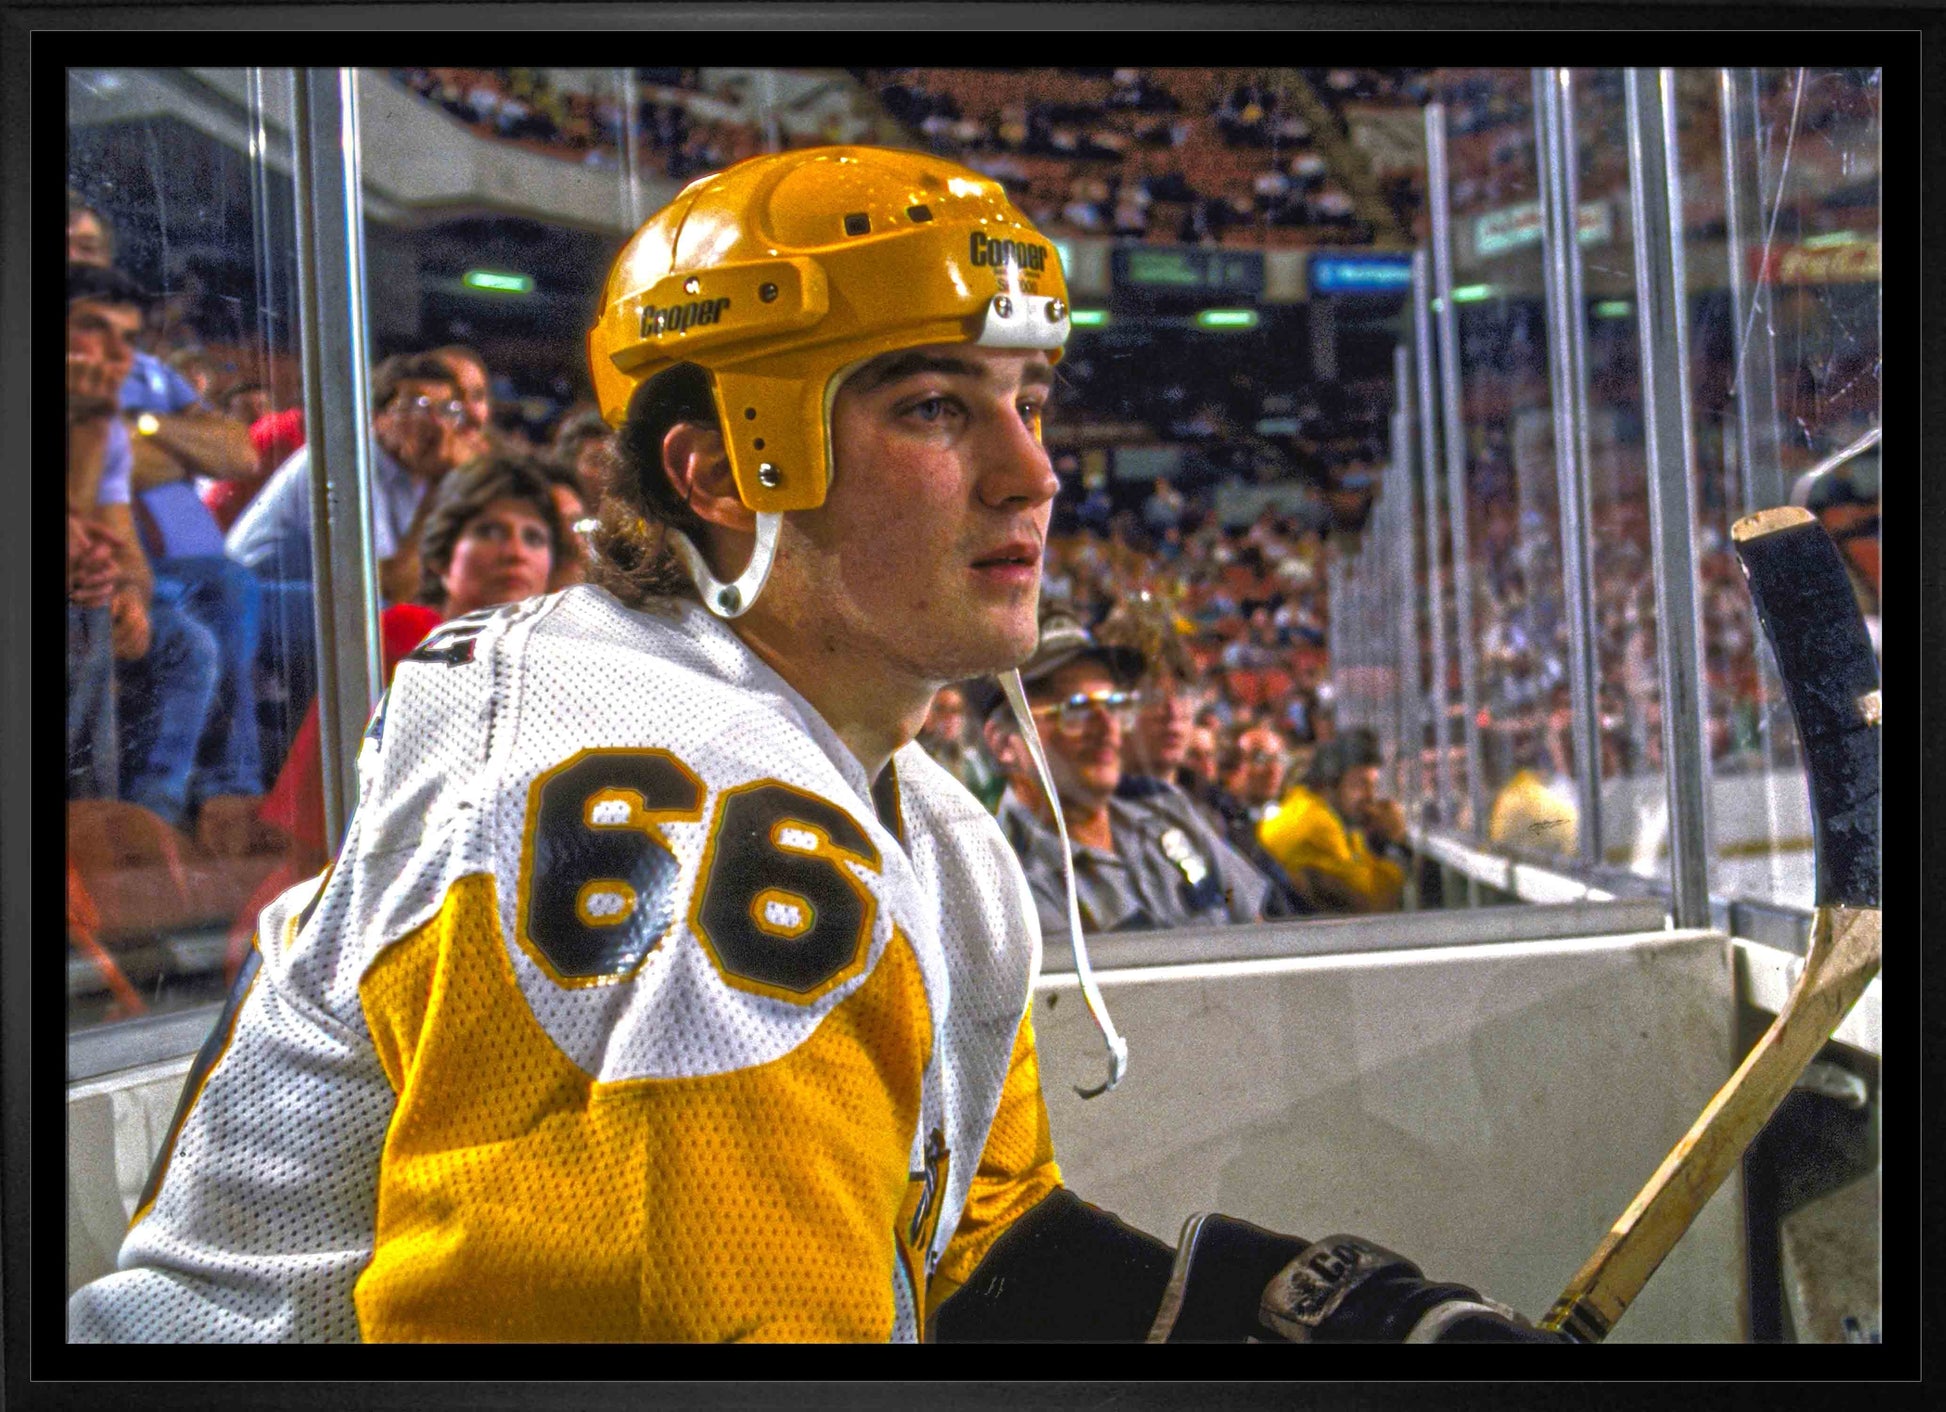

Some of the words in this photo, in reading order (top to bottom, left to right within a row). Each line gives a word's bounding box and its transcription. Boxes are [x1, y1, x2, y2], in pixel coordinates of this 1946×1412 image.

[969, 231, 1047, 272] Cooper
[641, 297, 730, 338] Cooper
[516, 747, 882, 1006] 66
